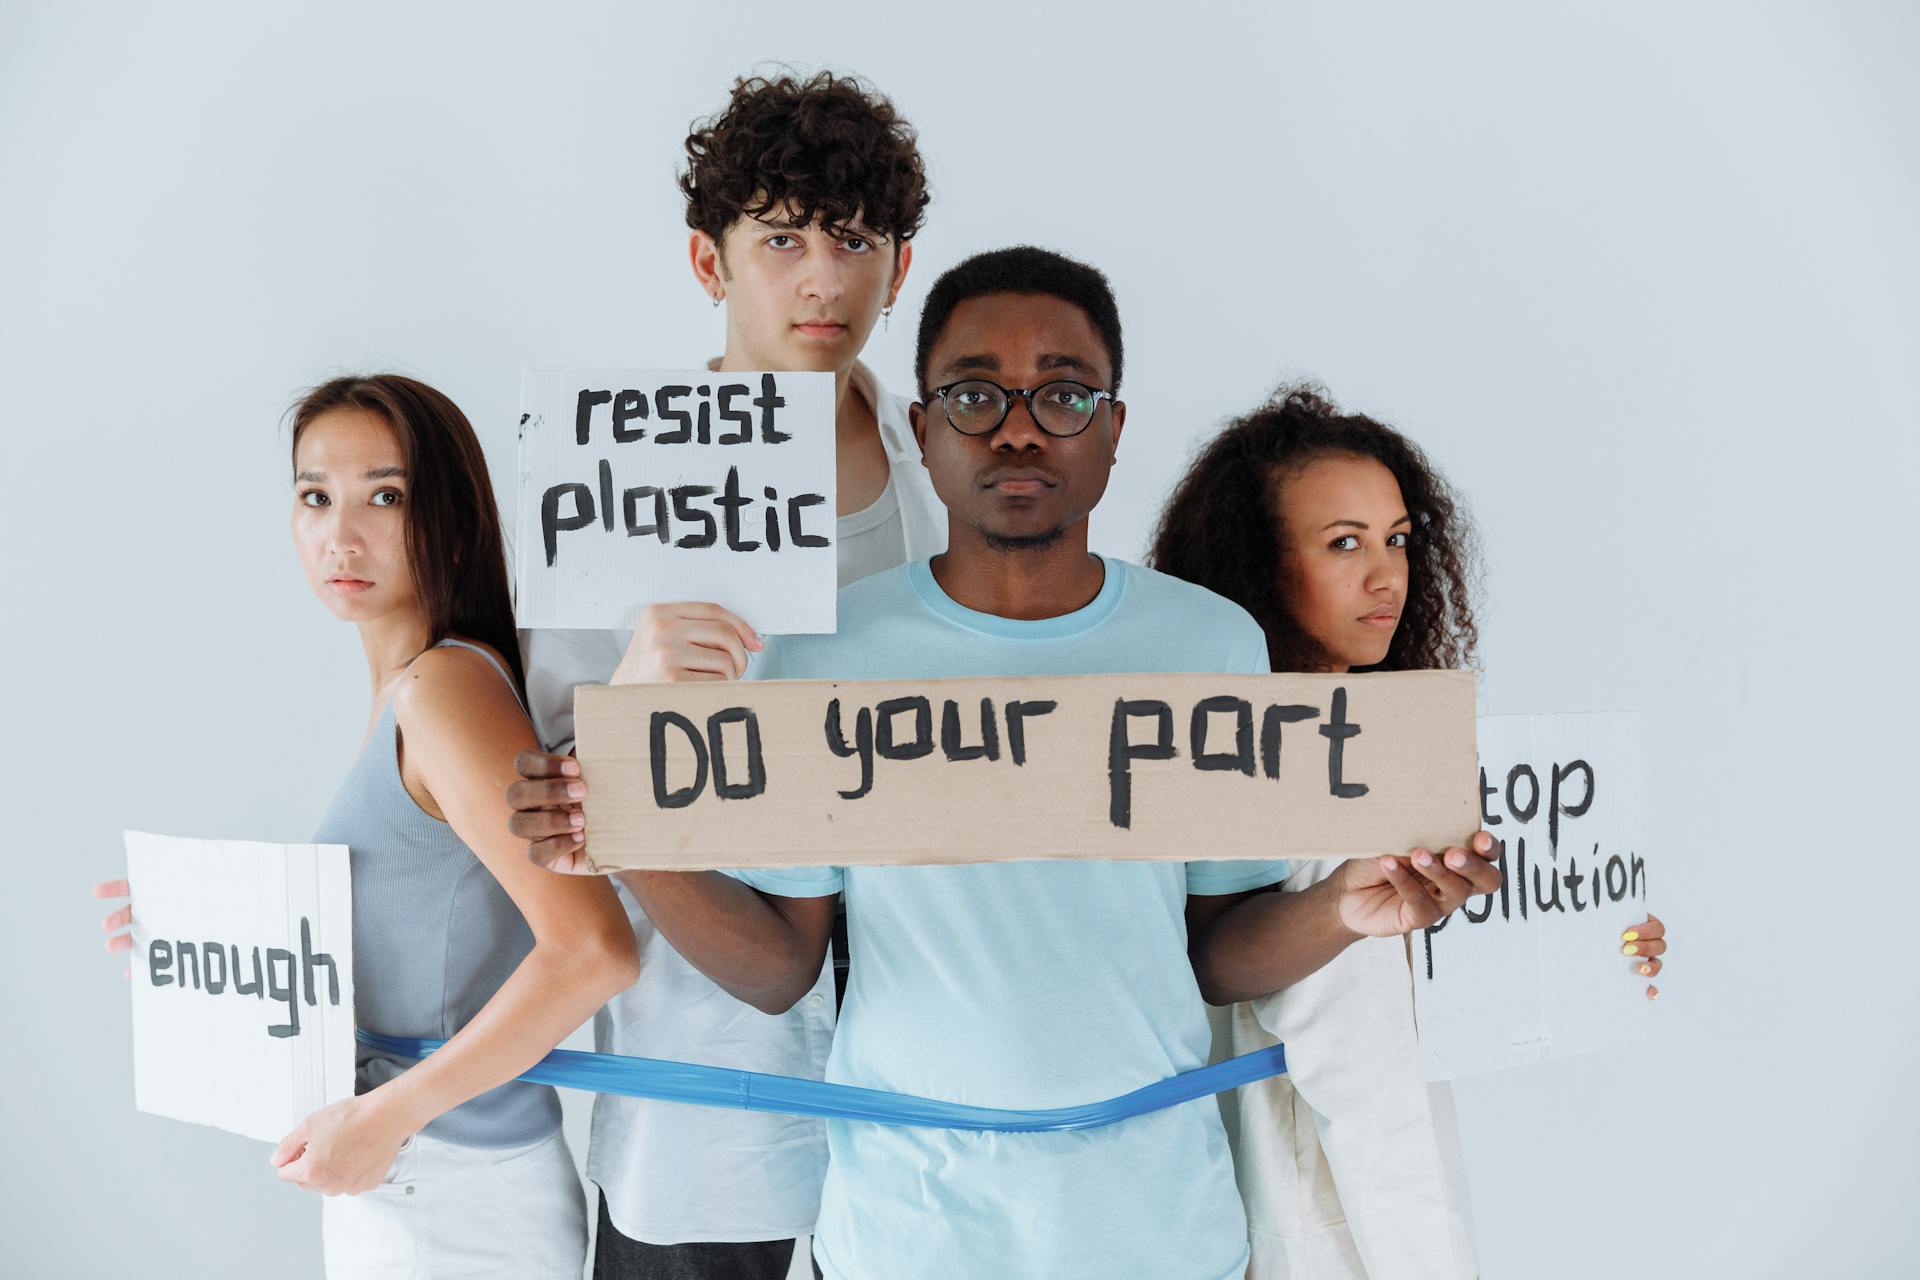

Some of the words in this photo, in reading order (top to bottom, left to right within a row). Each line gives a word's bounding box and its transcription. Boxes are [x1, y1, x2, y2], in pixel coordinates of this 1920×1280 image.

[576, 373, 792, 445] resist
[541, 458, 831, 567] plastic
[825, 695, 1057, 800] your
[1108, 687, 1370, 829] part
[1479, 759, 1595, 860] top
[149, 917, 340, 1038] enough
